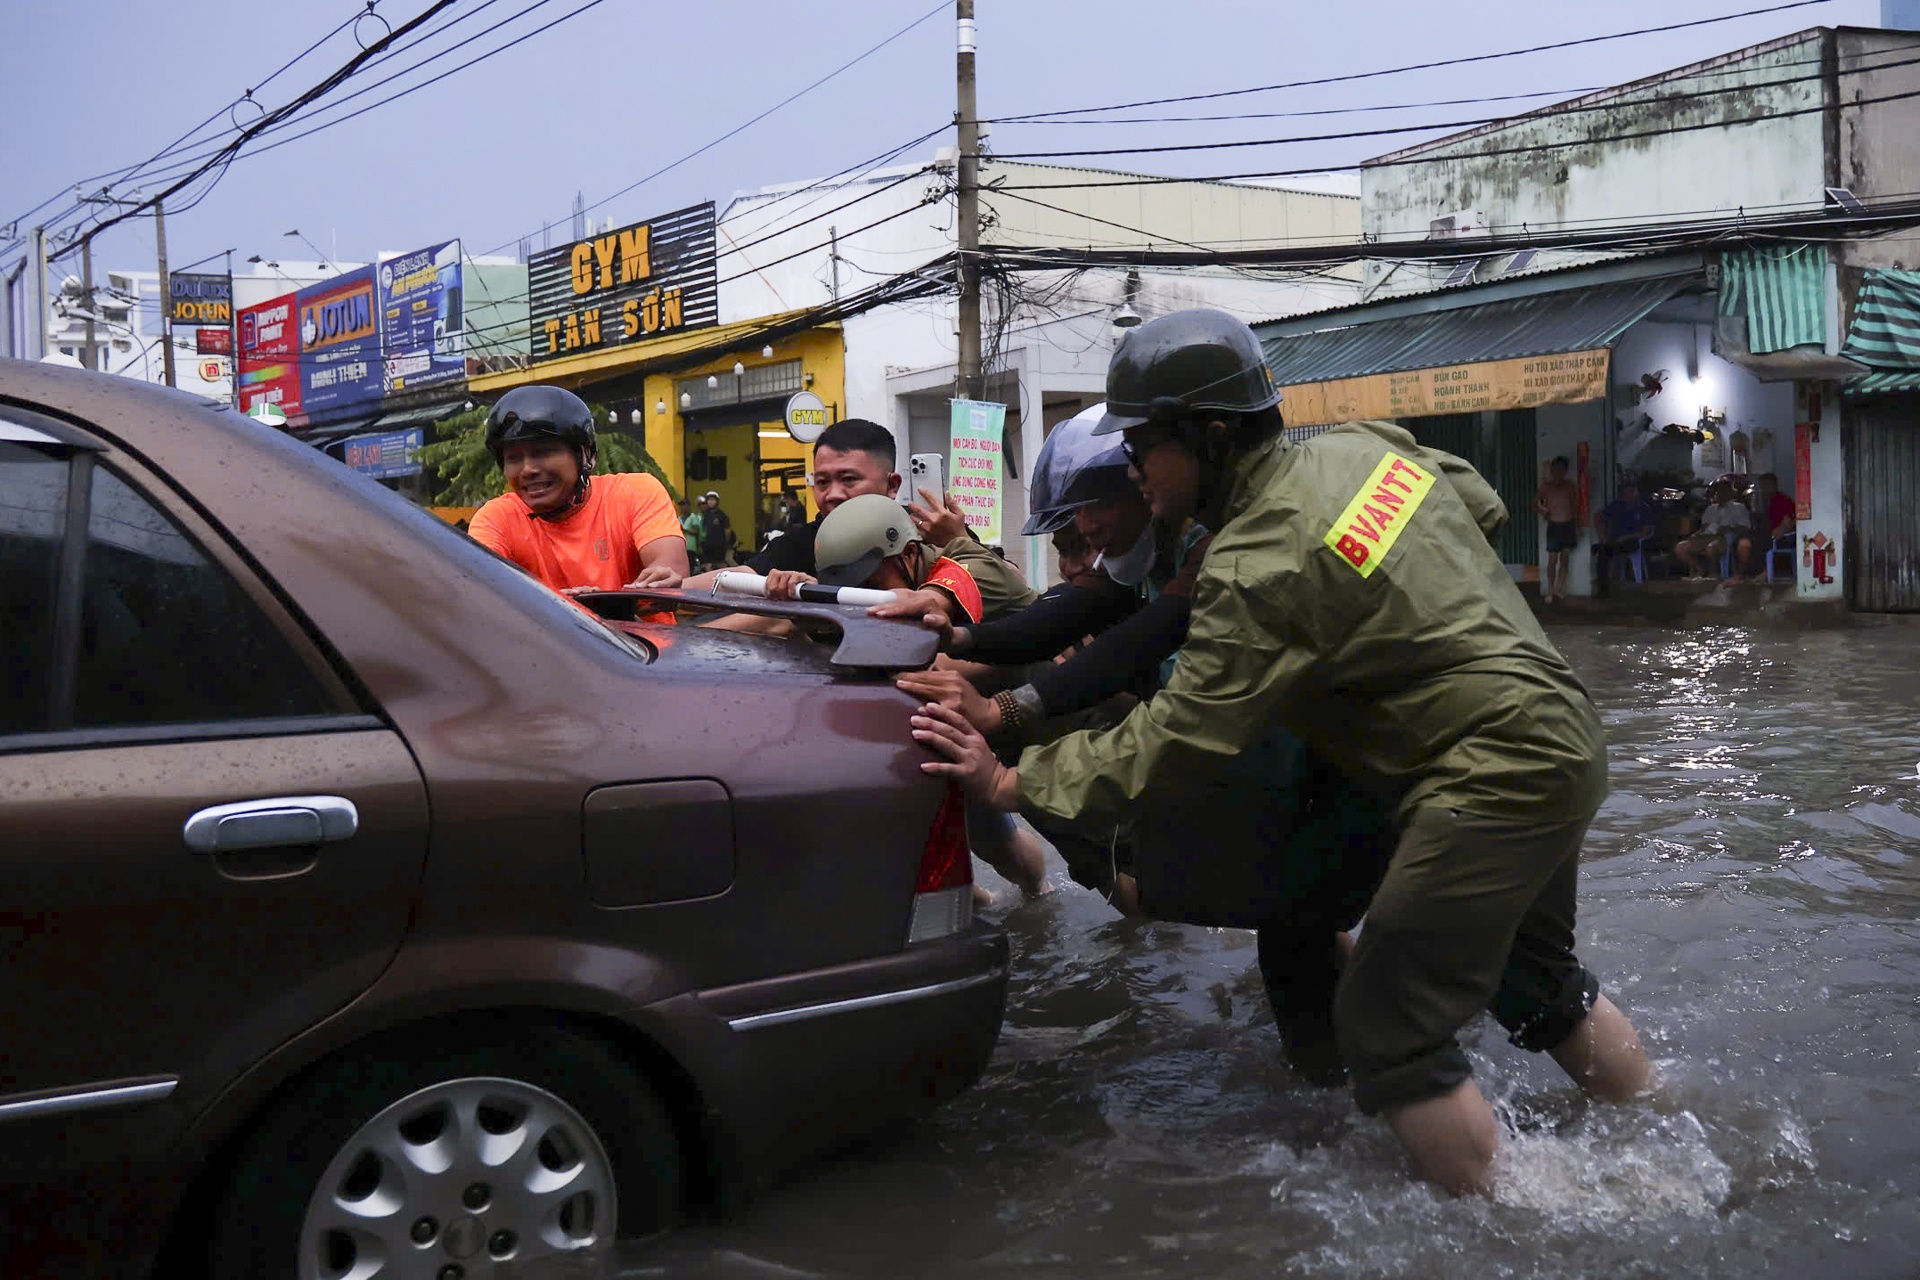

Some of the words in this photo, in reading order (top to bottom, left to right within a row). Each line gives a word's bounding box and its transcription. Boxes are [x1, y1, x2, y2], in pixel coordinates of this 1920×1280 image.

[571, 225, 651, 295] GYM
[172, 278, 230, 298] Dulux
[173, 301, 231, 320] JOTUN
[257, 304, 289, 327] NIPPON
[318, 292, 371, 342] JOTUN
[623, 286, 682, 337] SƠN
[259, 322, 285, 342] PAINT
[311, 368, 337, 389] MINH
[337, 358, 368, 383] THIỆN
[791, 409, 824, 425] GYM
[1336, 459, 1422, 568] BVANTT
